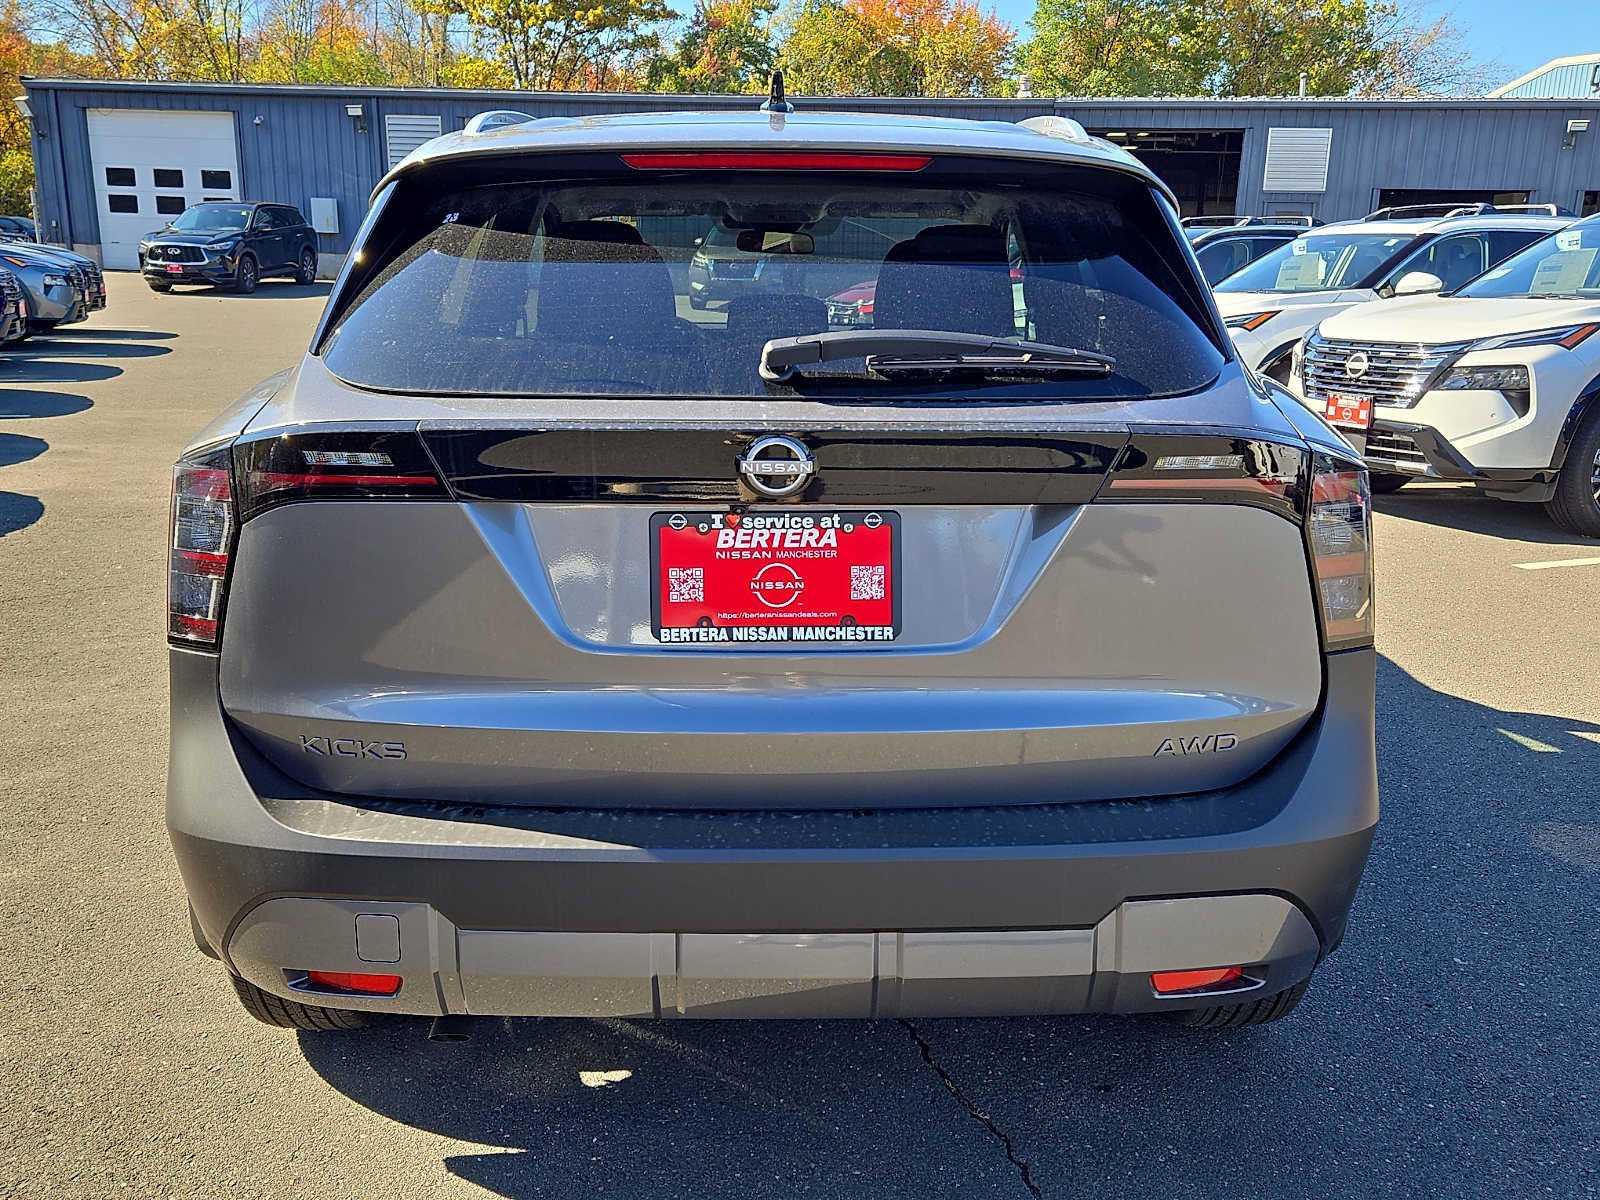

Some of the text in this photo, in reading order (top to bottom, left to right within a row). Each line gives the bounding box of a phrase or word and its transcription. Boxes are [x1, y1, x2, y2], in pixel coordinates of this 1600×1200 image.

[742, 463, 811, 473] NISSAN
[711, 513, 841, 529] I service at
[716, 528, 838, 549] BERTERA
[715, 550, 838, 560] NISSAN MANCHESTER
[750, 581, 805, 590] NISSAN
[660, 625, 894, 642] BERTERA NISSAN MANCHESTER
[299, 734, 408, 760] KICKS
[1152, 733, 1239, 758] AWD
